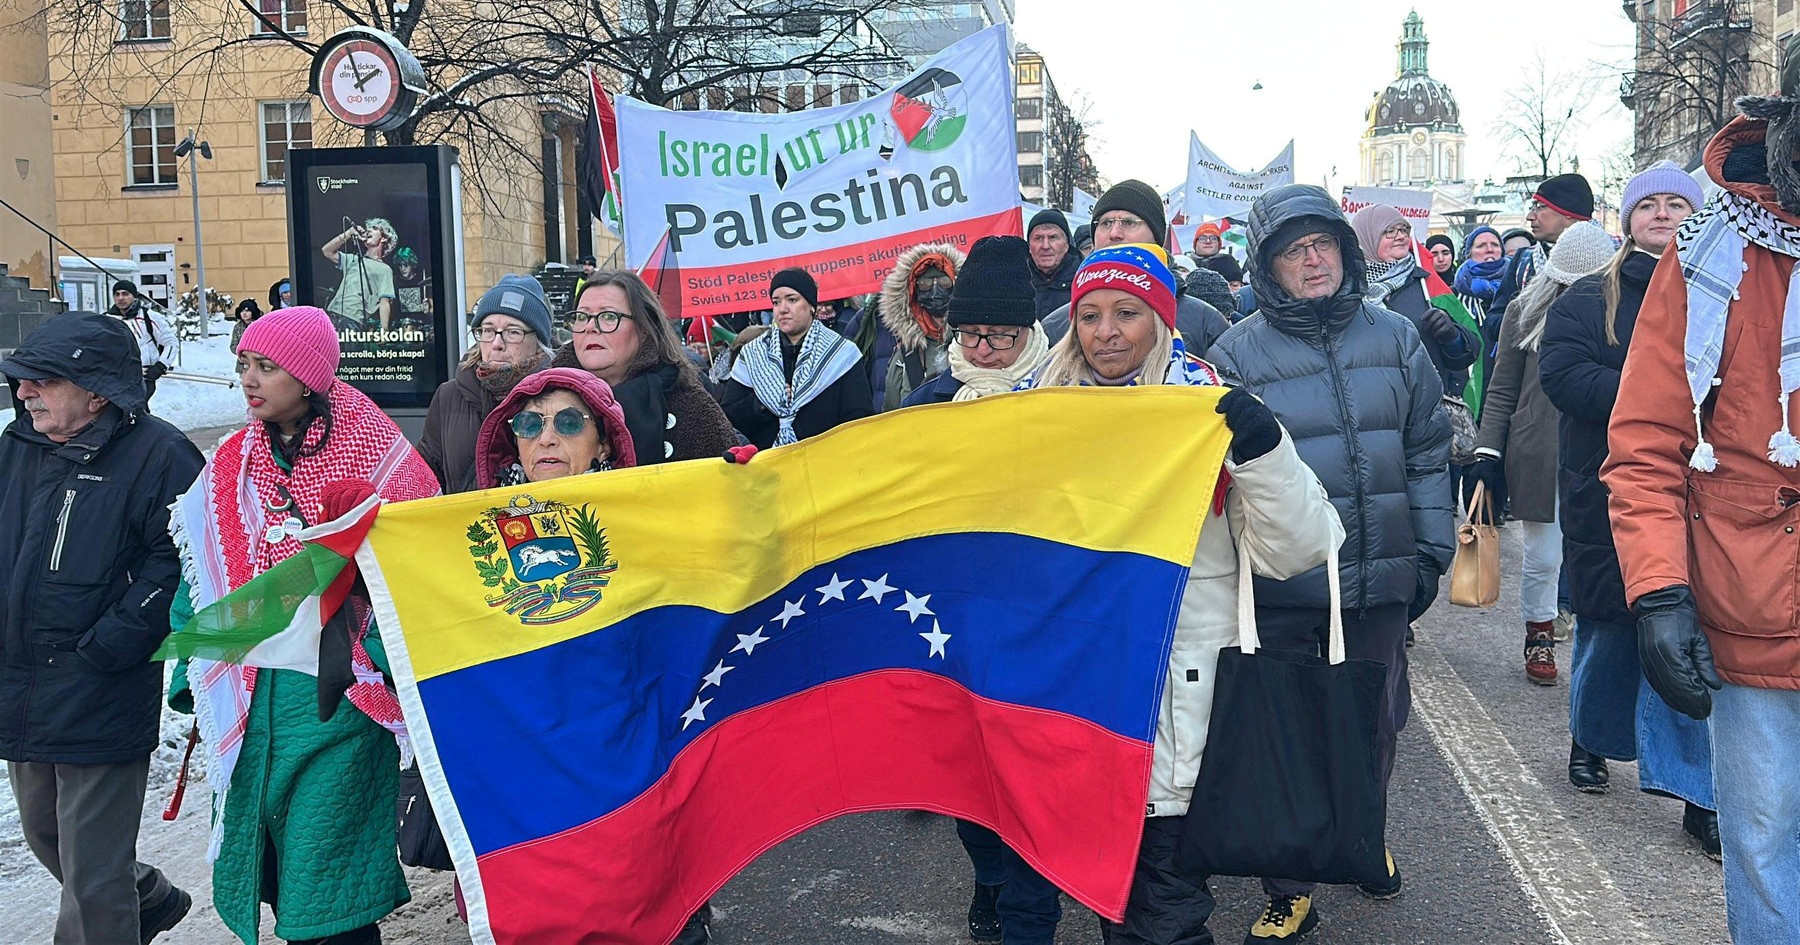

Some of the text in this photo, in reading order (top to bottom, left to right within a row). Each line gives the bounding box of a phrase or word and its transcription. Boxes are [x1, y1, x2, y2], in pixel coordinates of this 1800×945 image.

[658, 112, 875, 177] Israel ut ur
[1228, 181, 1265, 190] AGAINST
[1196, 186, 1260, 202] SETTLER COLO
[664, 164, 968, 253] Palestina
[1394, 206, 1430, 218] HILDREN
[688, 275, 723, 289] Stöd
[727, 255, 865, 285] Palestiruppens
[1076, 268, 1152, 291] Venezuela
[691, 293, 731, 306] Swish
[735, 290, 757, 302] 123
[760, 288, 771, 299] 9
[336, 328, 423, 342] ulturskolan
[346, 349, 375, 359] scrolla,
[376, 349, 397, 359] börja
[399, 349, 425, 359] skapa!
[339, 365, 359, 375] något
[385, 365, 396, 373] din
[396, 365, 413, 373] fritid
[395, 374, 413, 382] idag.
